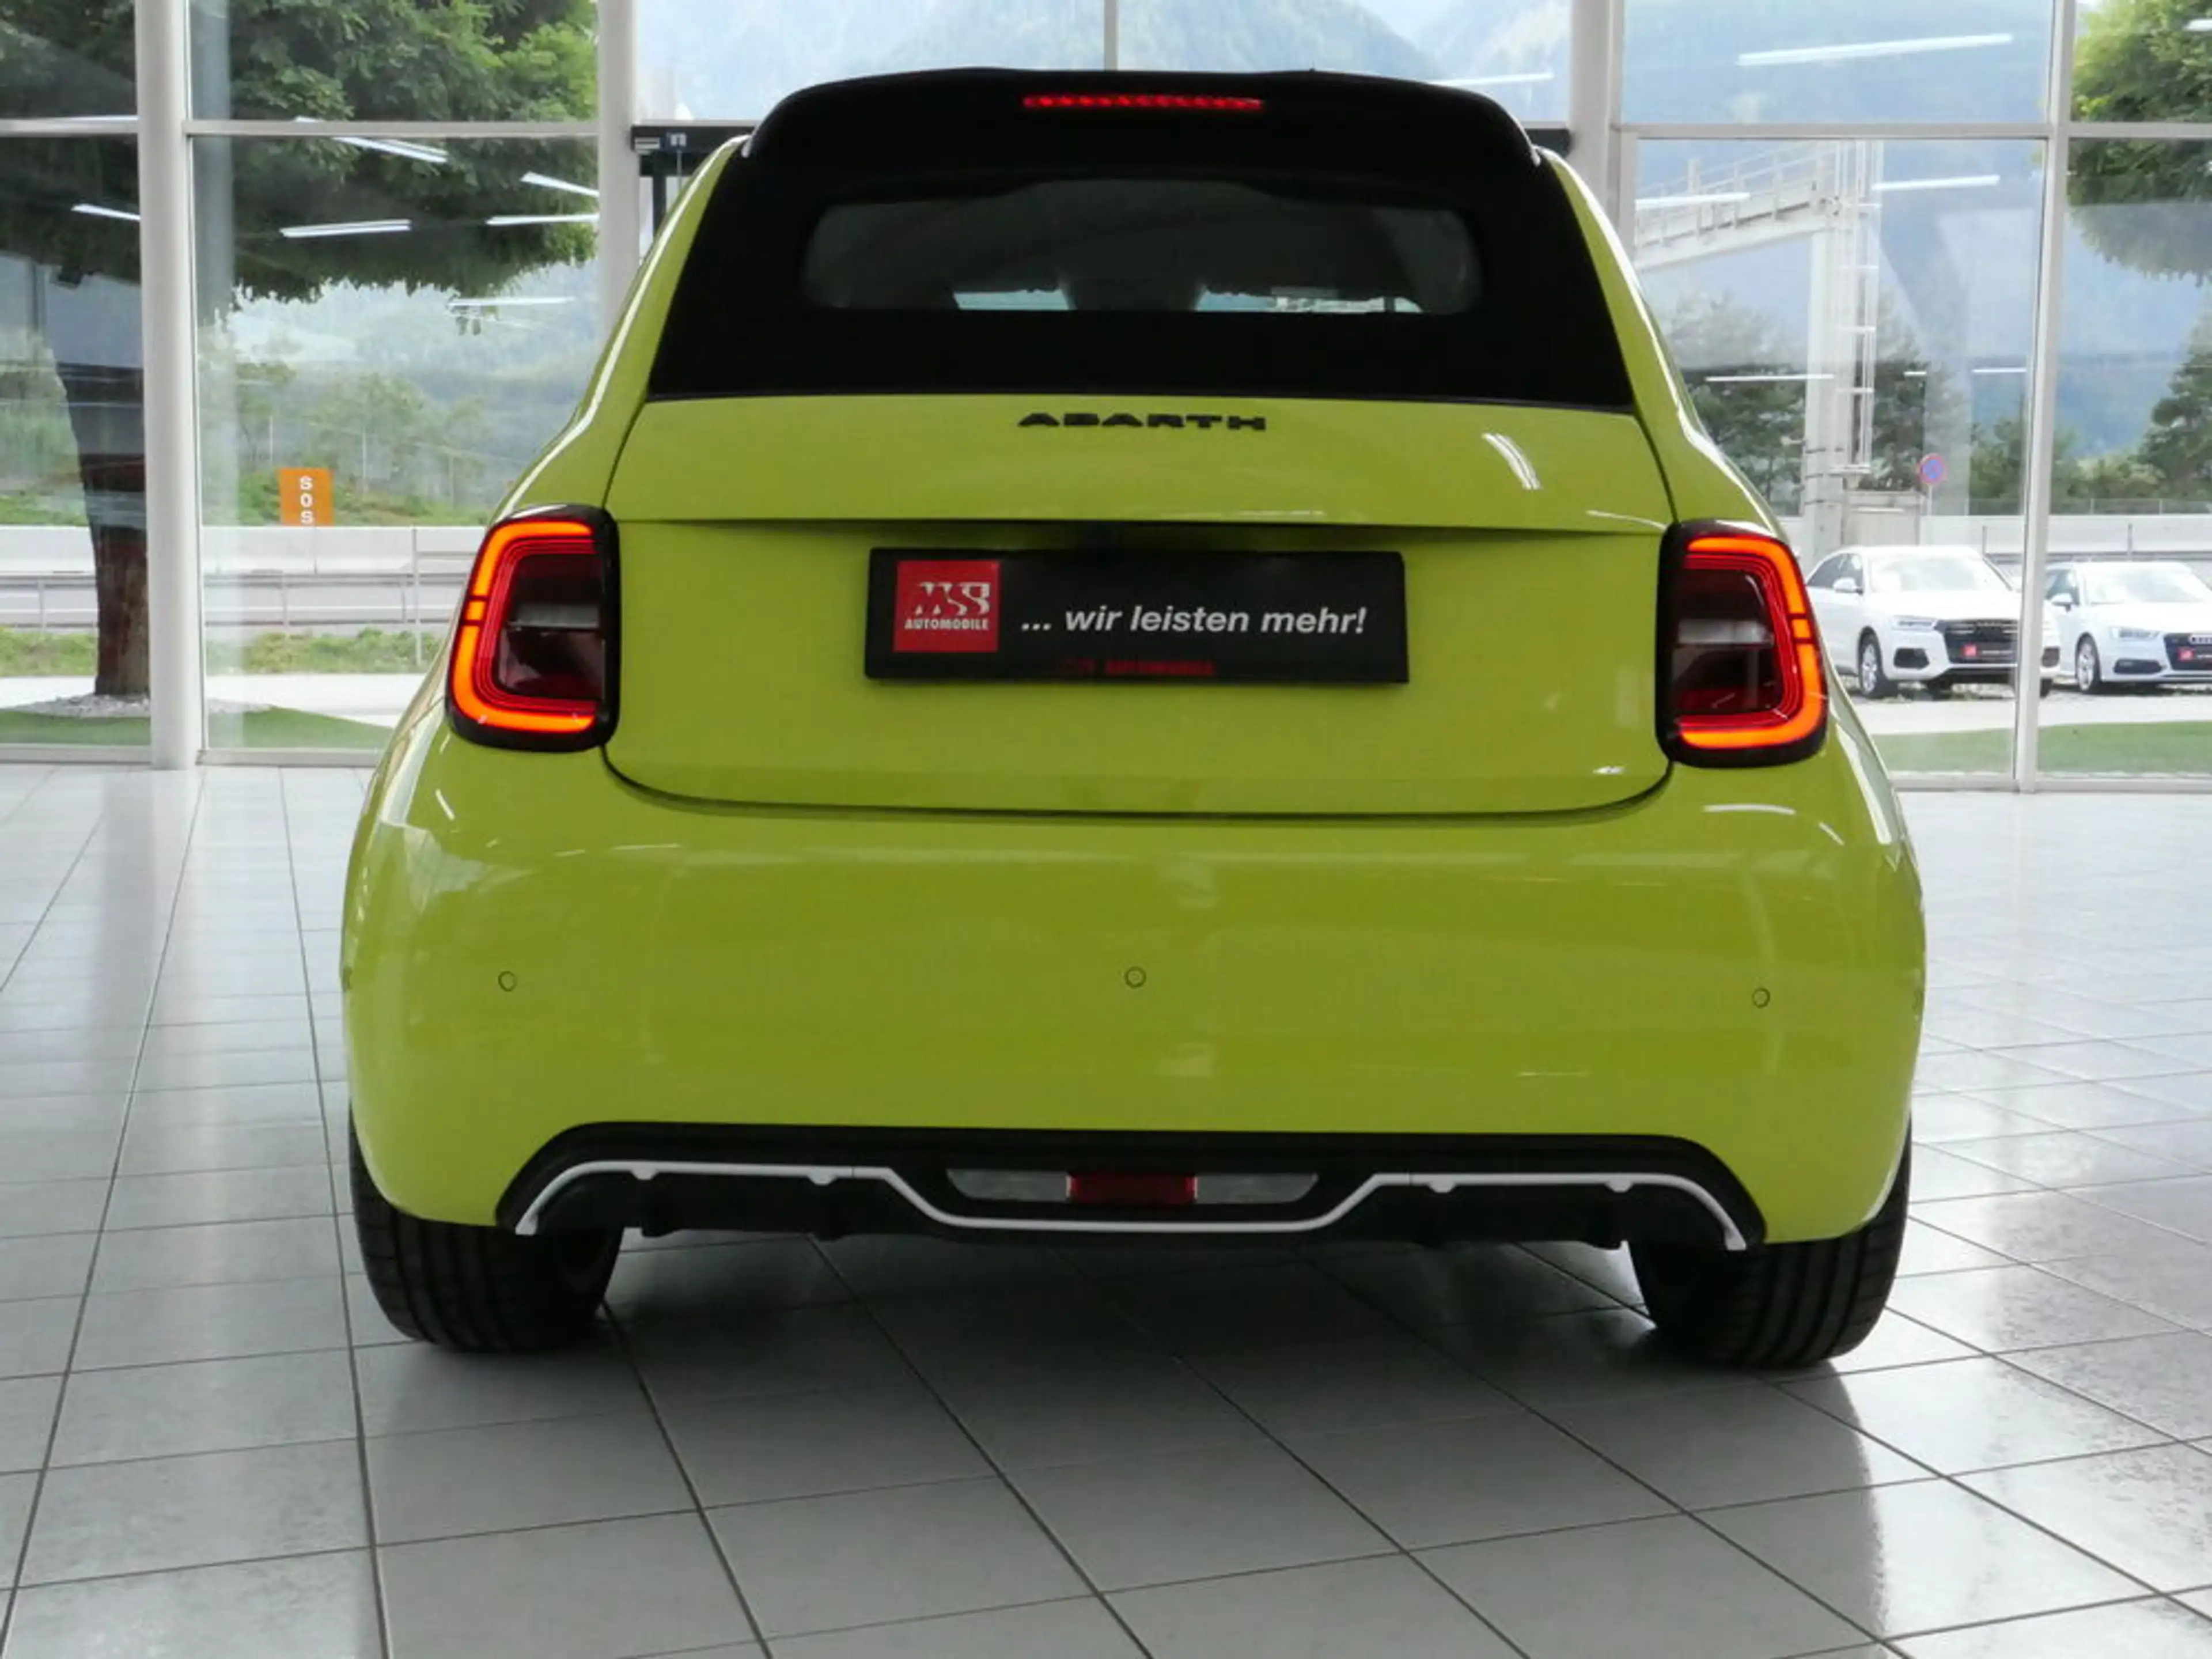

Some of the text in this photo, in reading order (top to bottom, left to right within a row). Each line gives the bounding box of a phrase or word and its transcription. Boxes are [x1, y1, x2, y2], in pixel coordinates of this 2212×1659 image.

[1018, 413, 1266, 431] ABARTH
[300, 475, 313, 525] SOS
[904, 618, 989, 630] AUTOMOBILE
[1066, 604, 1123, 631] wir
[1130, 605, 1249, 632] leisten
[1260, 607, 1367, 634] mehr!
